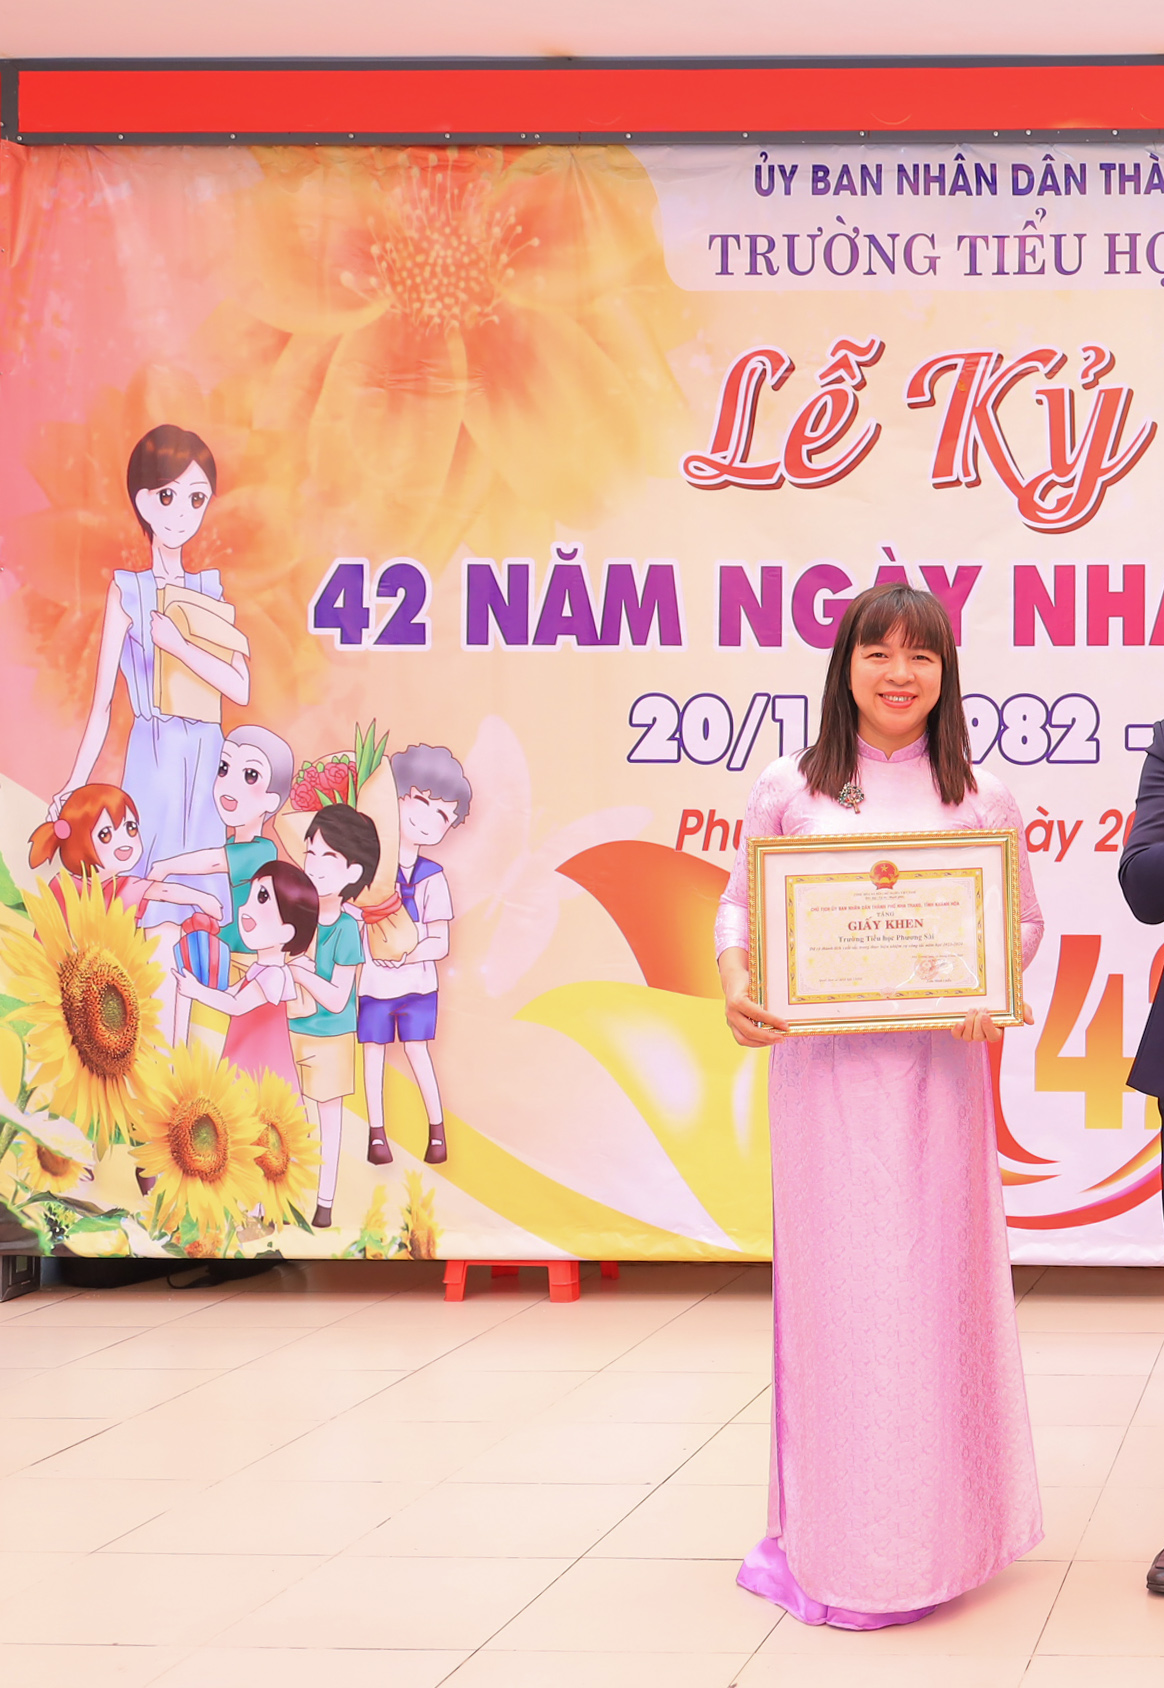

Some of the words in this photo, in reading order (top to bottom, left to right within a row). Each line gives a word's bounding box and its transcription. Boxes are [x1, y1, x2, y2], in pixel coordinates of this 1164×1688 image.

[754, 151, 799, 197] ỦY
[811, 163, 883, 196] BAN
[897, 153, 998, 196] NHÂN
[1011, 153, 1087, 196] DÂN
[708, 215, 941, 276] TRƯỜNG
[957, 207, 1087, 276] TIỂU
[681, 335, 885, 490] Lễ
[905, 345, 1158, 534] Kỷ
[313, 562, 428, 646] 42
[466, 547, 683, 646] NĂM
[847, 916, 881, 931] GIẤY
[885, 918, 924, 930] KHEN
